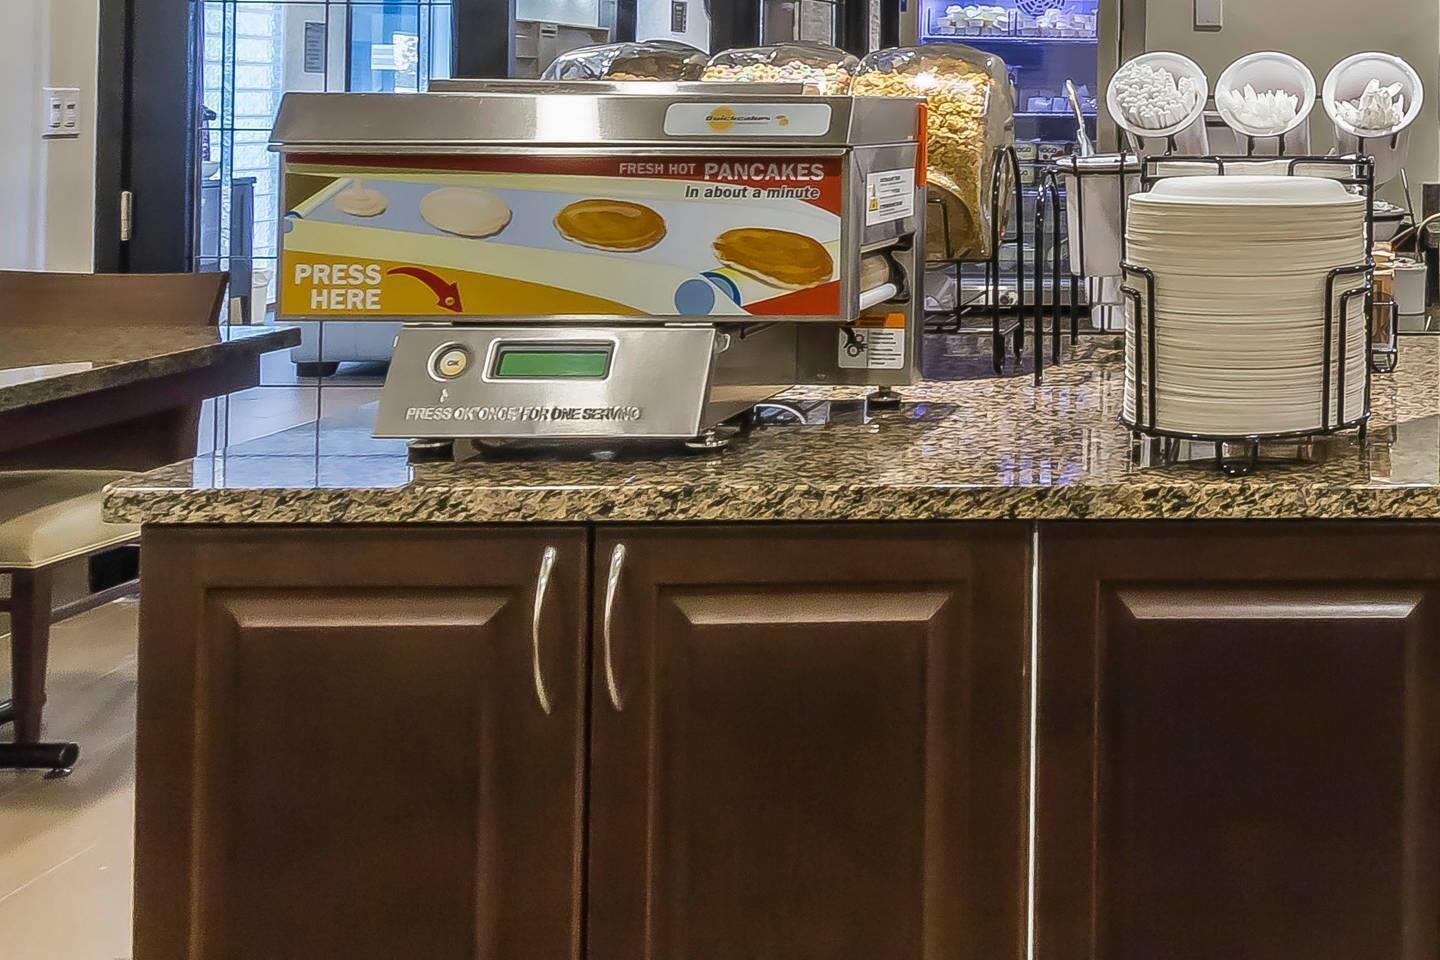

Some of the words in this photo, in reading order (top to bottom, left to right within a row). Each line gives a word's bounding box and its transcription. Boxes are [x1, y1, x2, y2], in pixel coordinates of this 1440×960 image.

[619, 162, 664, 175] FRESH
[669, 163, 696, 175] HOT
[704, 163, 824, 181] PANCAKES
[704, 186, 748, 198] about
[752, 188, 761, 198] a
[766, 186, 819, 199] minute
[294, 263, 382, 286] PRESS
[310, 288, 381, 310] HERE
[406, 407, 453, 421] PRESS
[520, 407, 551, 421] FOR
[550, 407, 581, 421] ONE
